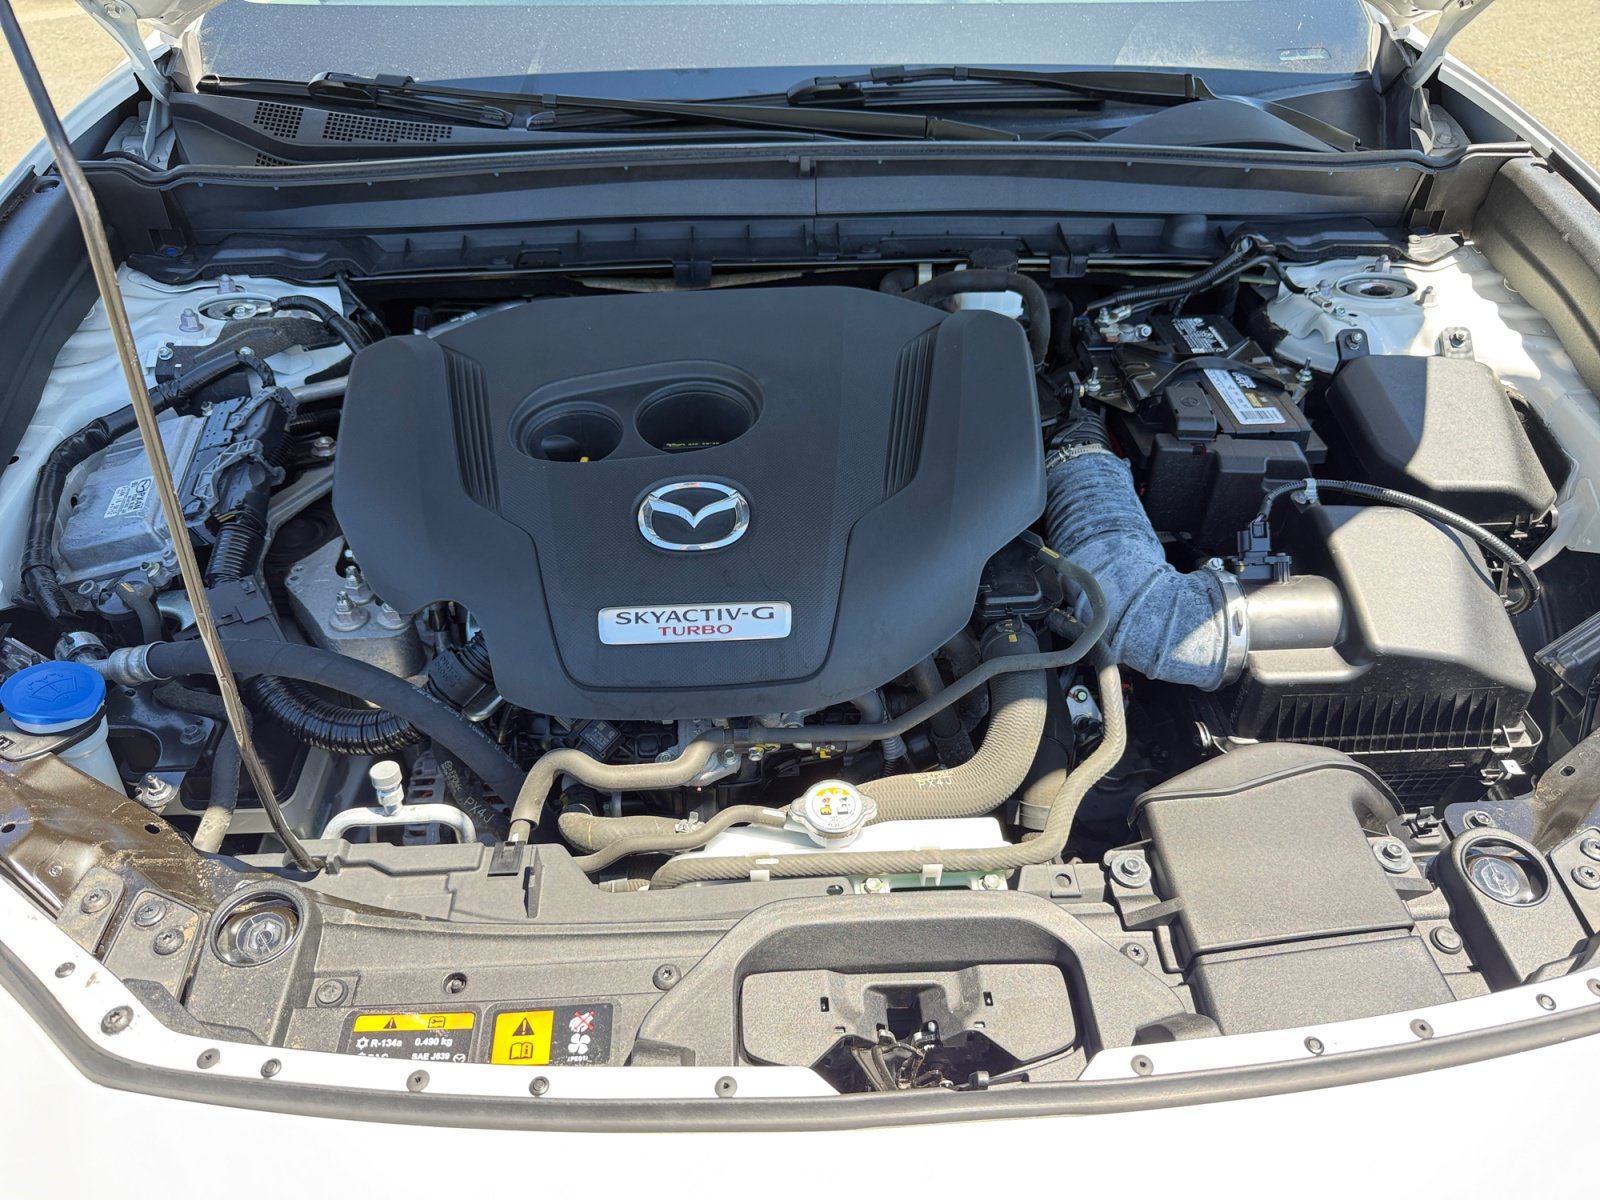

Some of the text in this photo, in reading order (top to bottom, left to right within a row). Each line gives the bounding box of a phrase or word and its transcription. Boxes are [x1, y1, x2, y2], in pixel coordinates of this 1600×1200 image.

[615, 606, 775, 625] SKYACTIV-G
[658, 624, 733, 637] TURBO
[370, 1037, 453, 1048] R-134a 0.490 kg
[411, 1052, 430, 1061] SAE
